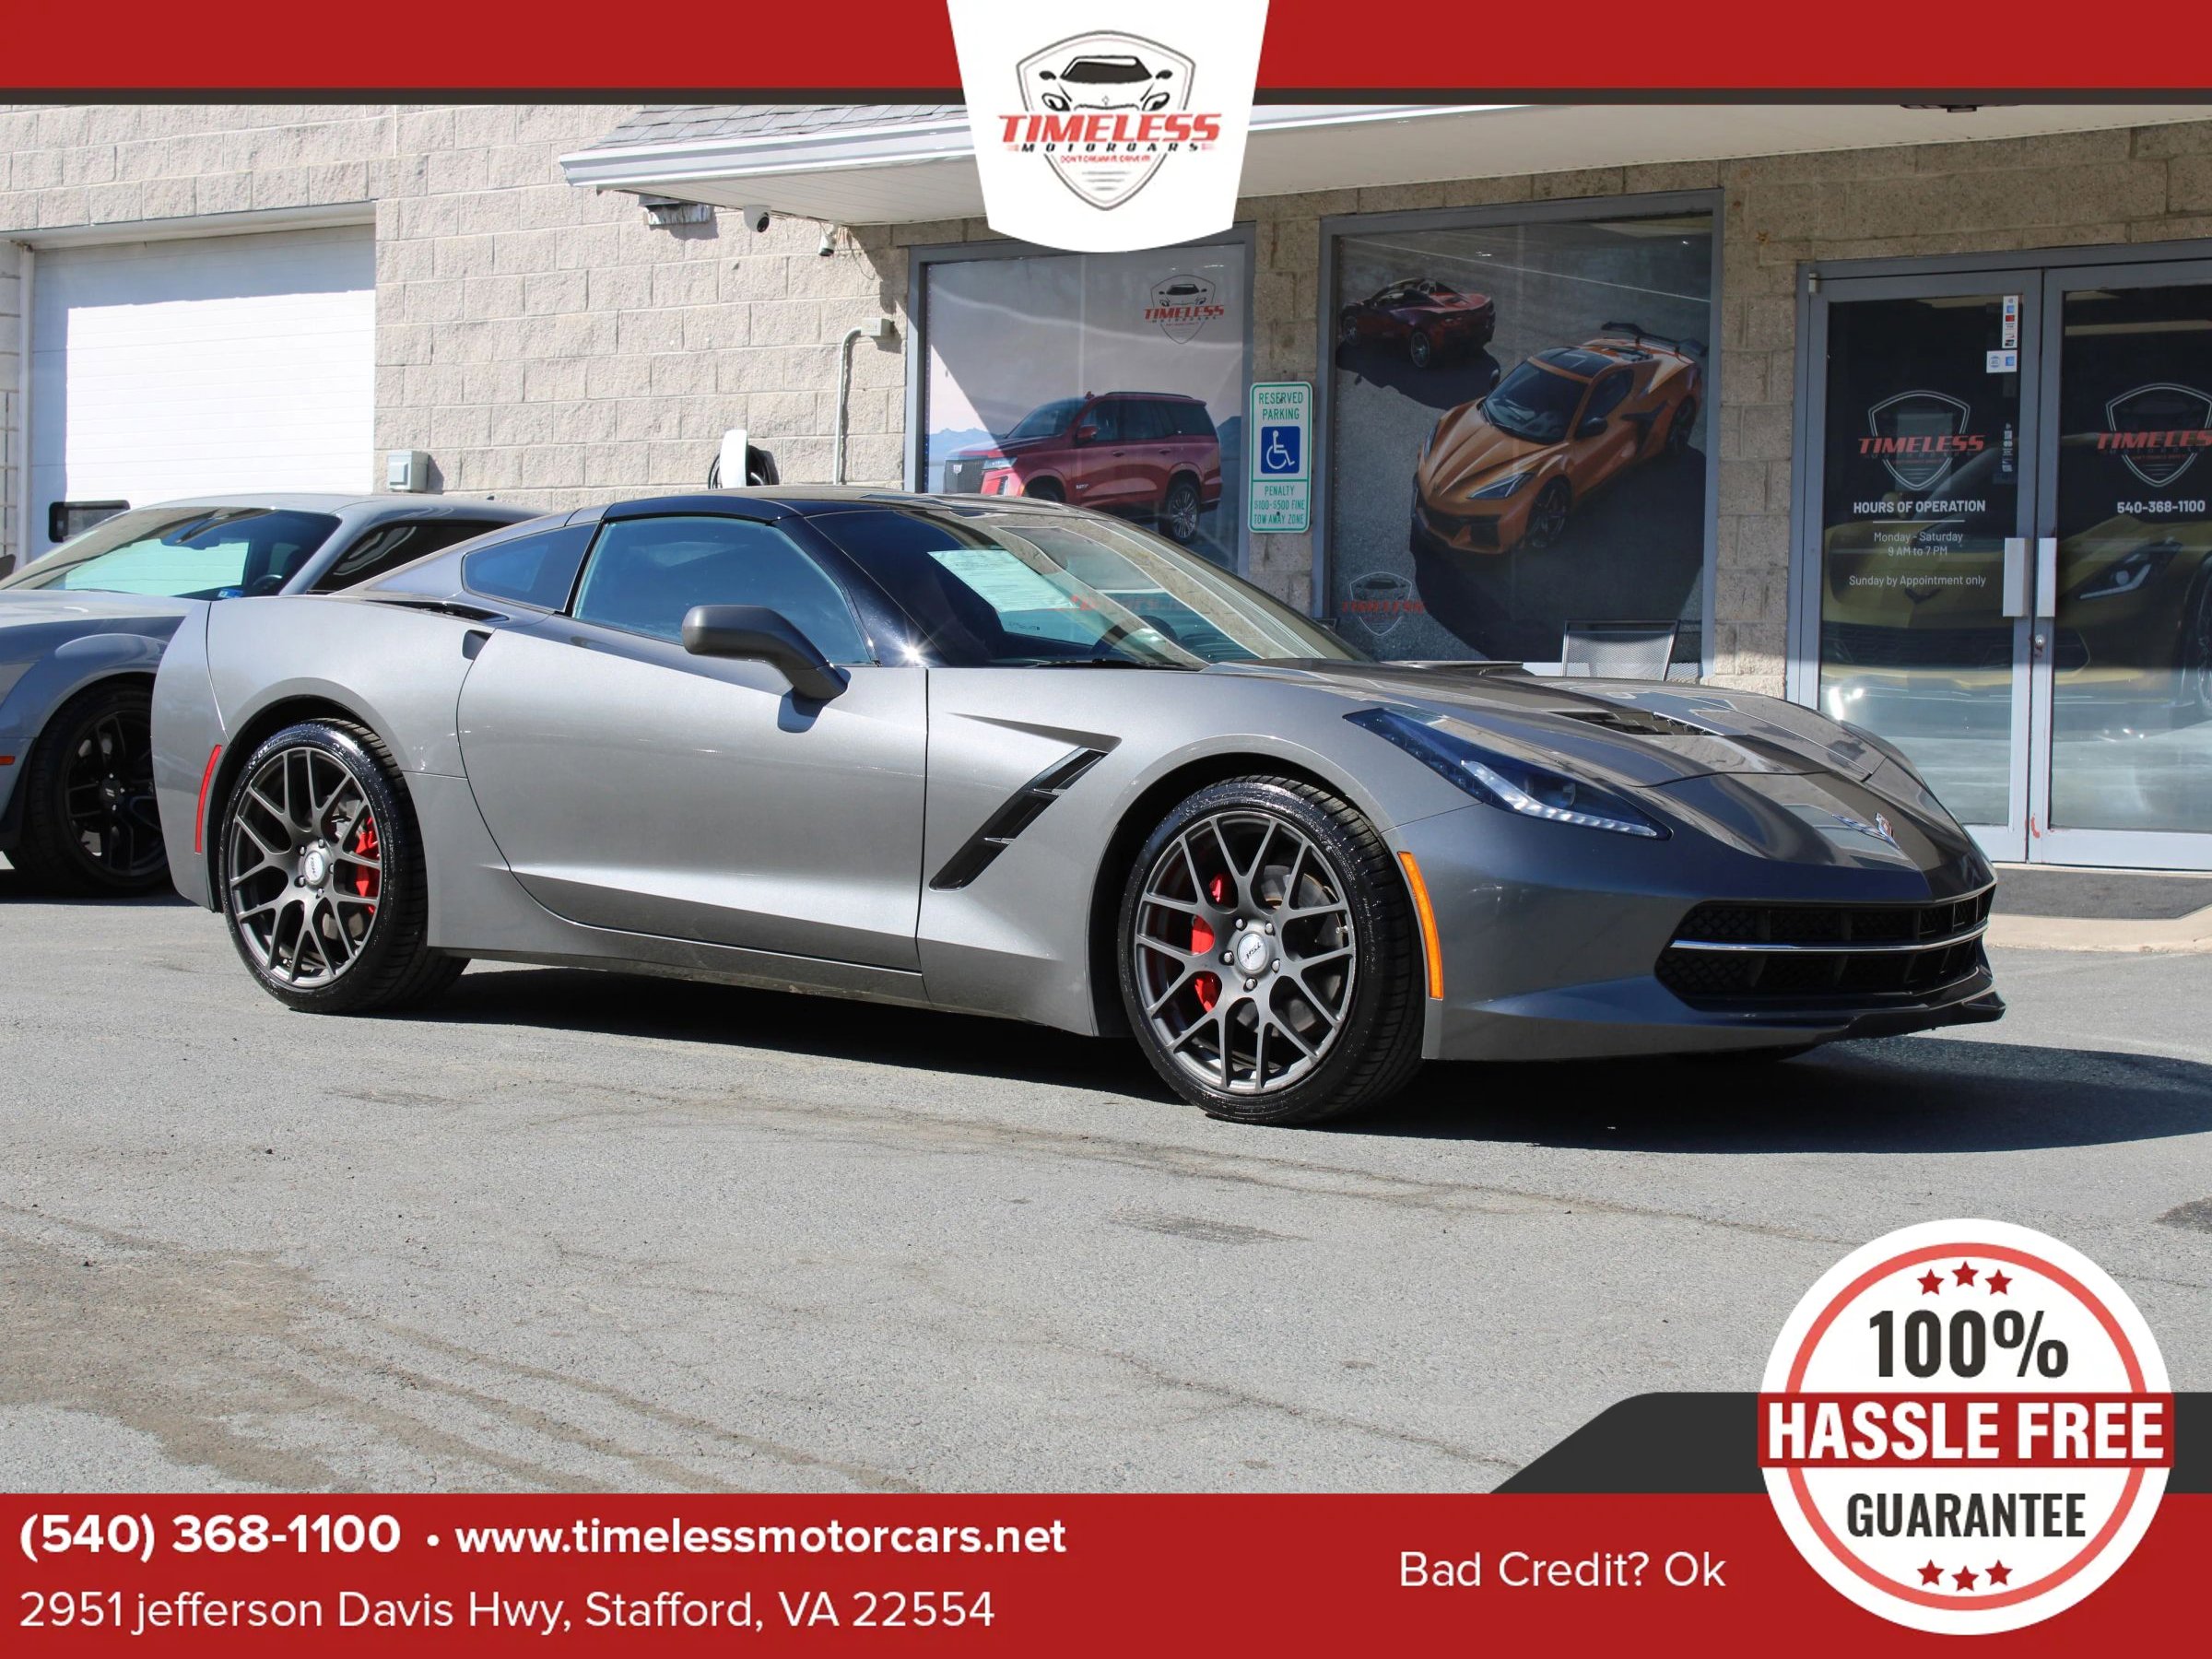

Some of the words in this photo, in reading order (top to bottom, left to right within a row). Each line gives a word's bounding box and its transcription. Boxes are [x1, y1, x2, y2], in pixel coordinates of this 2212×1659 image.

[1144, 305, 1225, 320] TIMELESS
[1258, 392, 1303, 405] RESERVED
[1262, 408, 1300, 421] PARKING
[1858, 435, 1987, 453] TIMELESS
[1265, 485, 1295, 496] PENALTY
[1291, 500, 1305, 510] FINE
[1853, 501, 1894, 513] HOURS
[1897, 501, 1913, 513] OF
[1915, 500, 1986, 513] OPERATION
[2117, 500, 2206, 513] 540-368-1100
[1253, 514, 1266, 524] TOW
[1268, 514, 1286, 524] AWAY
[1288, 514, 1304, 524] ZONE
[1874, 532, 1911, 544] Monday
[1919, 532, 1963, 544] Saturday
[1888, 547, 1894, 557] 9
[1897, 547, 1911, 557] AM
[1913, 547, 1924, 557] to
[1925, 547, 1930, 556] 7
[1933, 547, 1947, 556] PM
[1849, 575, 1885, 587] Sunday
[1886, 575, 1898, 587] by
[1900, 575, 1964, 588] Appointment
[1965, 576, 1987, 587] only
